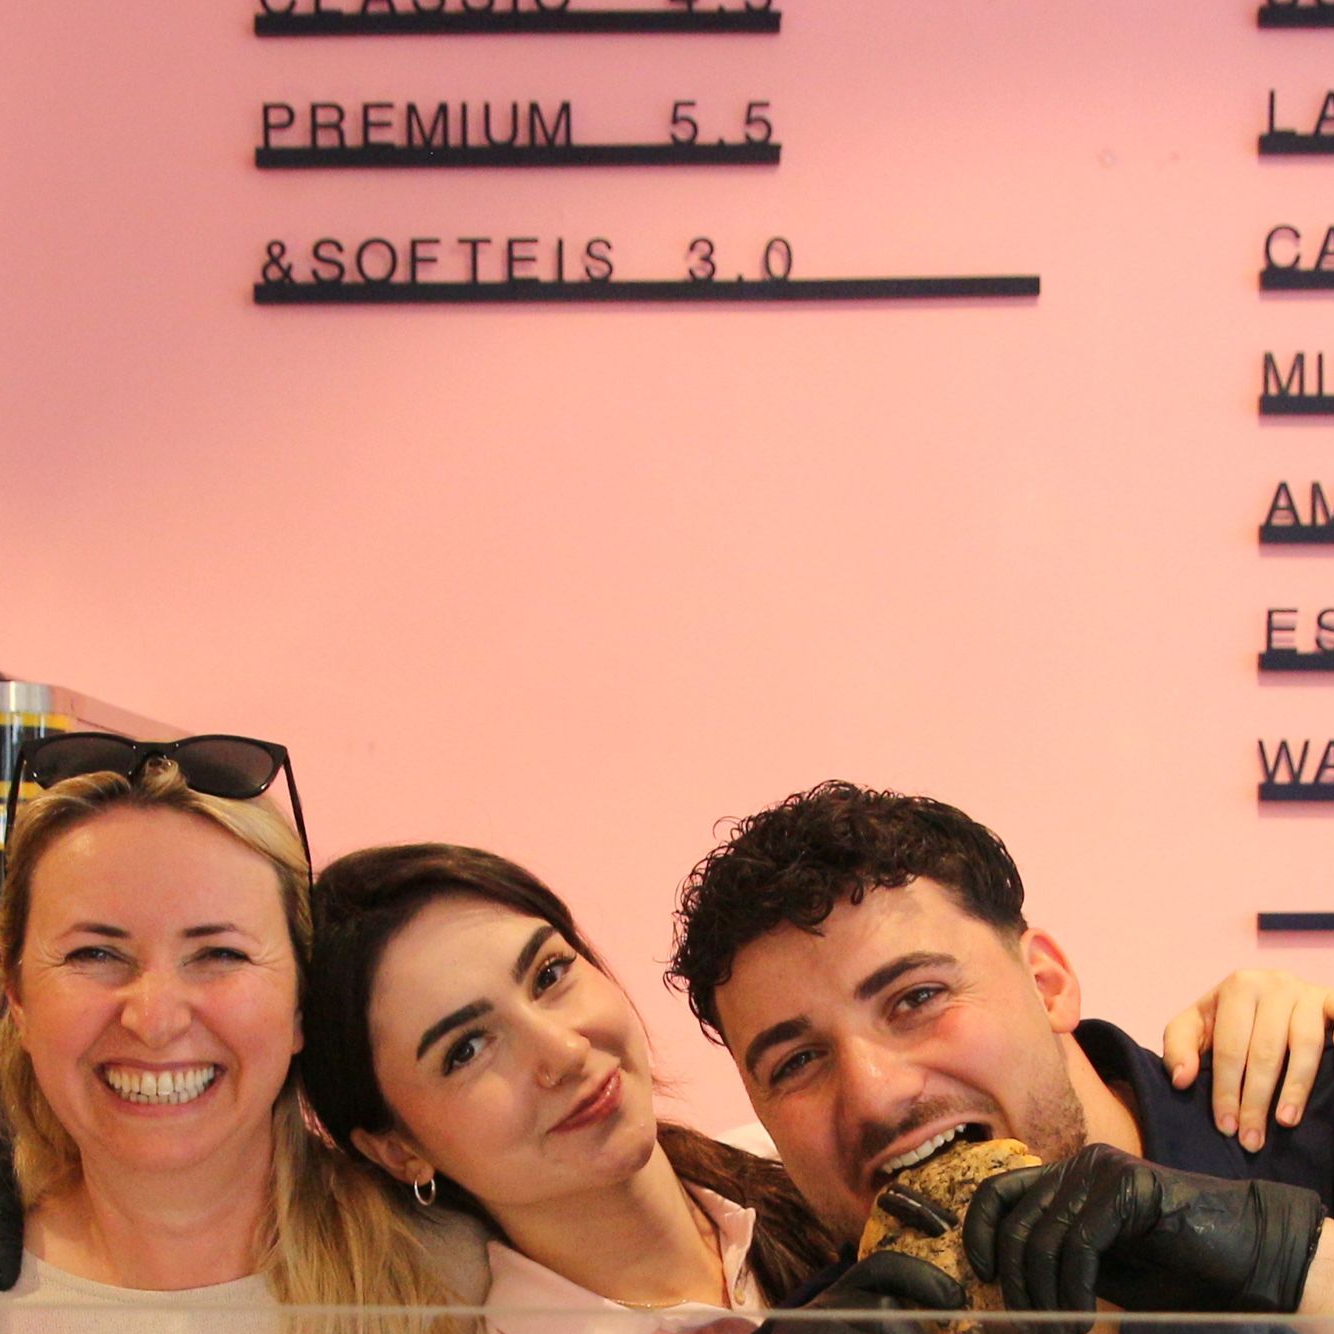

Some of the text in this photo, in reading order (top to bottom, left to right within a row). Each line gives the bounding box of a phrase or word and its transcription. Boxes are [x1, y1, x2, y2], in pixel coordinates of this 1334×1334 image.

[263, 102, 773, 148] PREMIUM 5.5
[688, 237, 794, 283] 3.0
